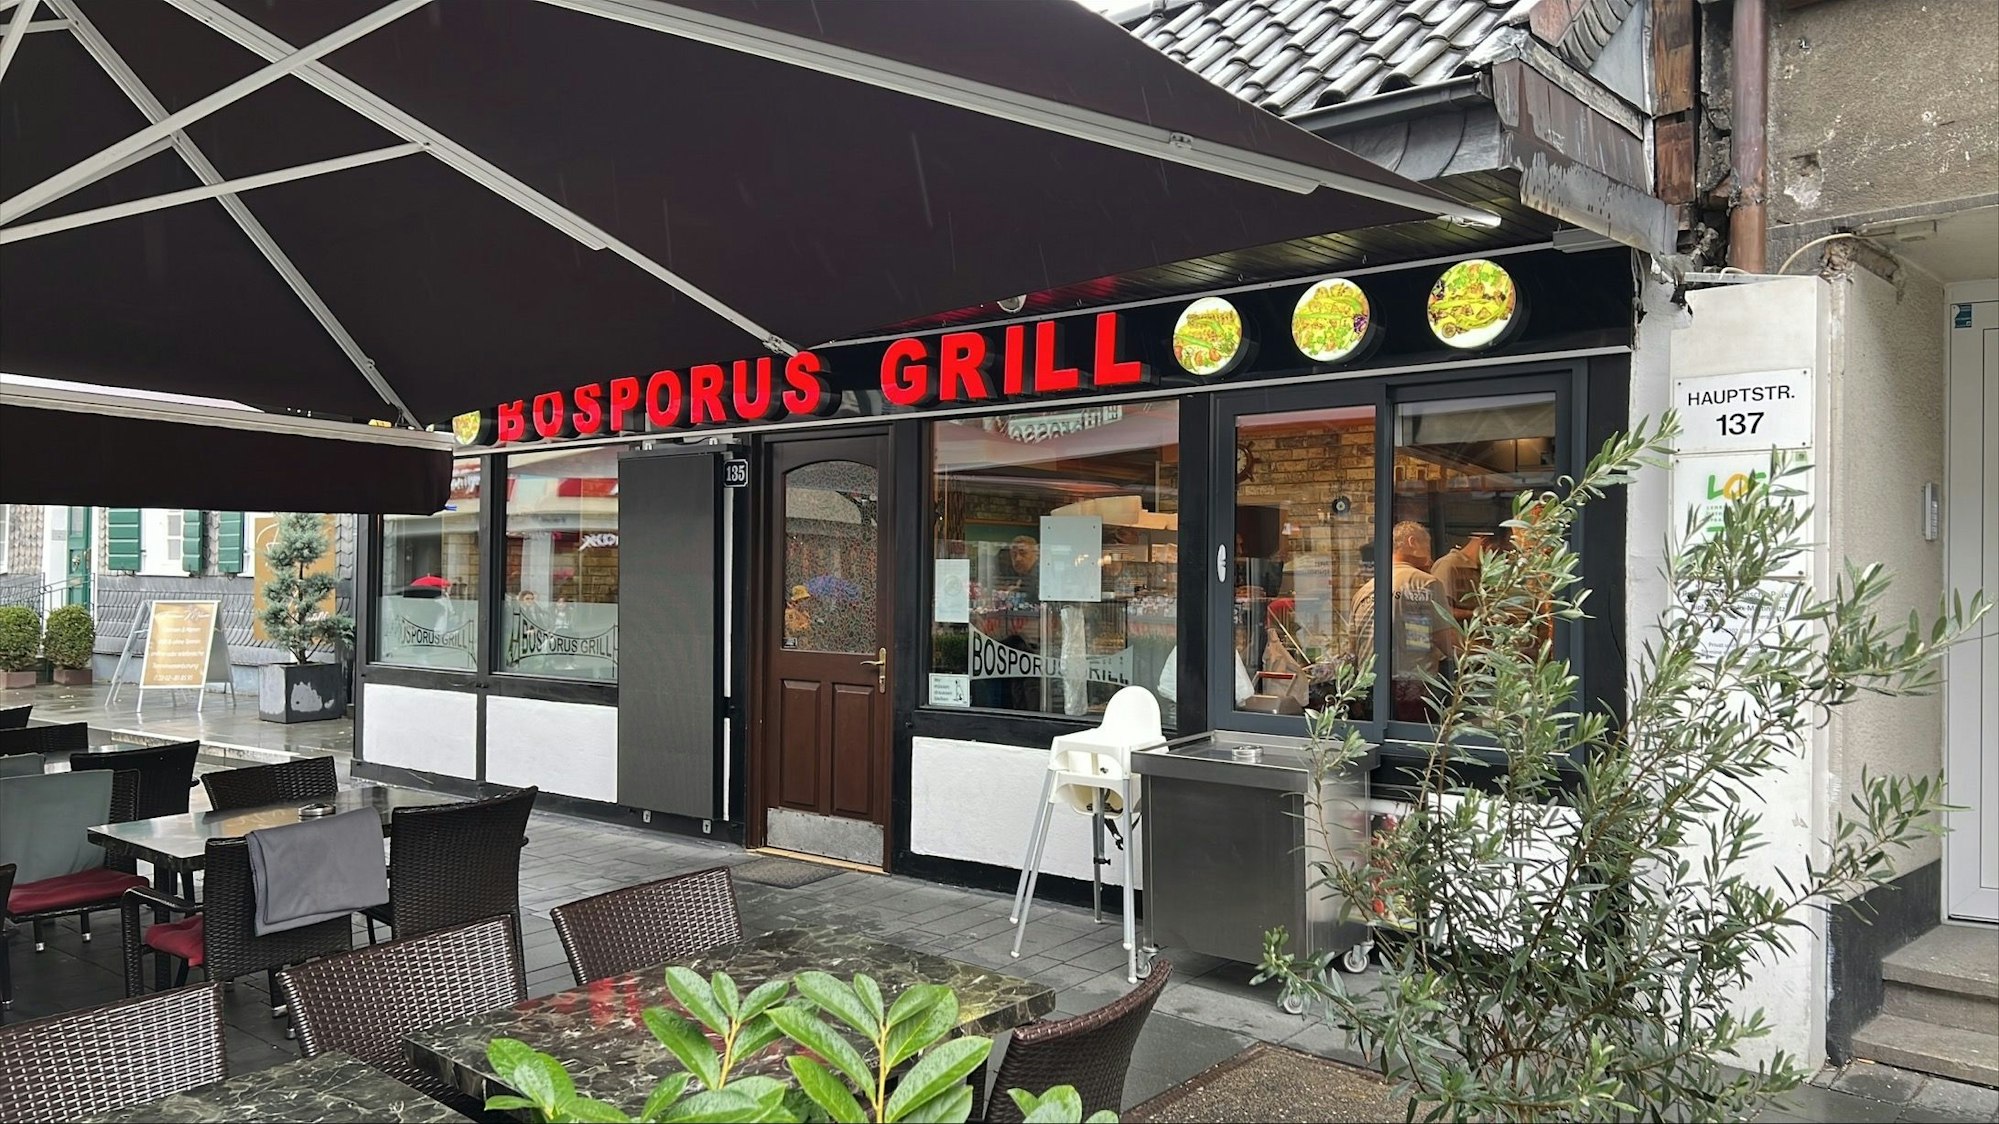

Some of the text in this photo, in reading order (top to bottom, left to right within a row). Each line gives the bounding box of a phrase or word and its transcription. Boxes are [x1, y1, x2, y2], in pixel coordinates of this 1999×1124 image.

[498, 311, 1141, 442] BOSPORUS GRILL
[1688, 385, 1795, 406] HAUPTSTR.
[1716, 411, 1765, 436] 137
[725, 465, 746, 482] 135
[442, 628, 468, 649] GRILL
[580, 634, 612, 658] GRILL
